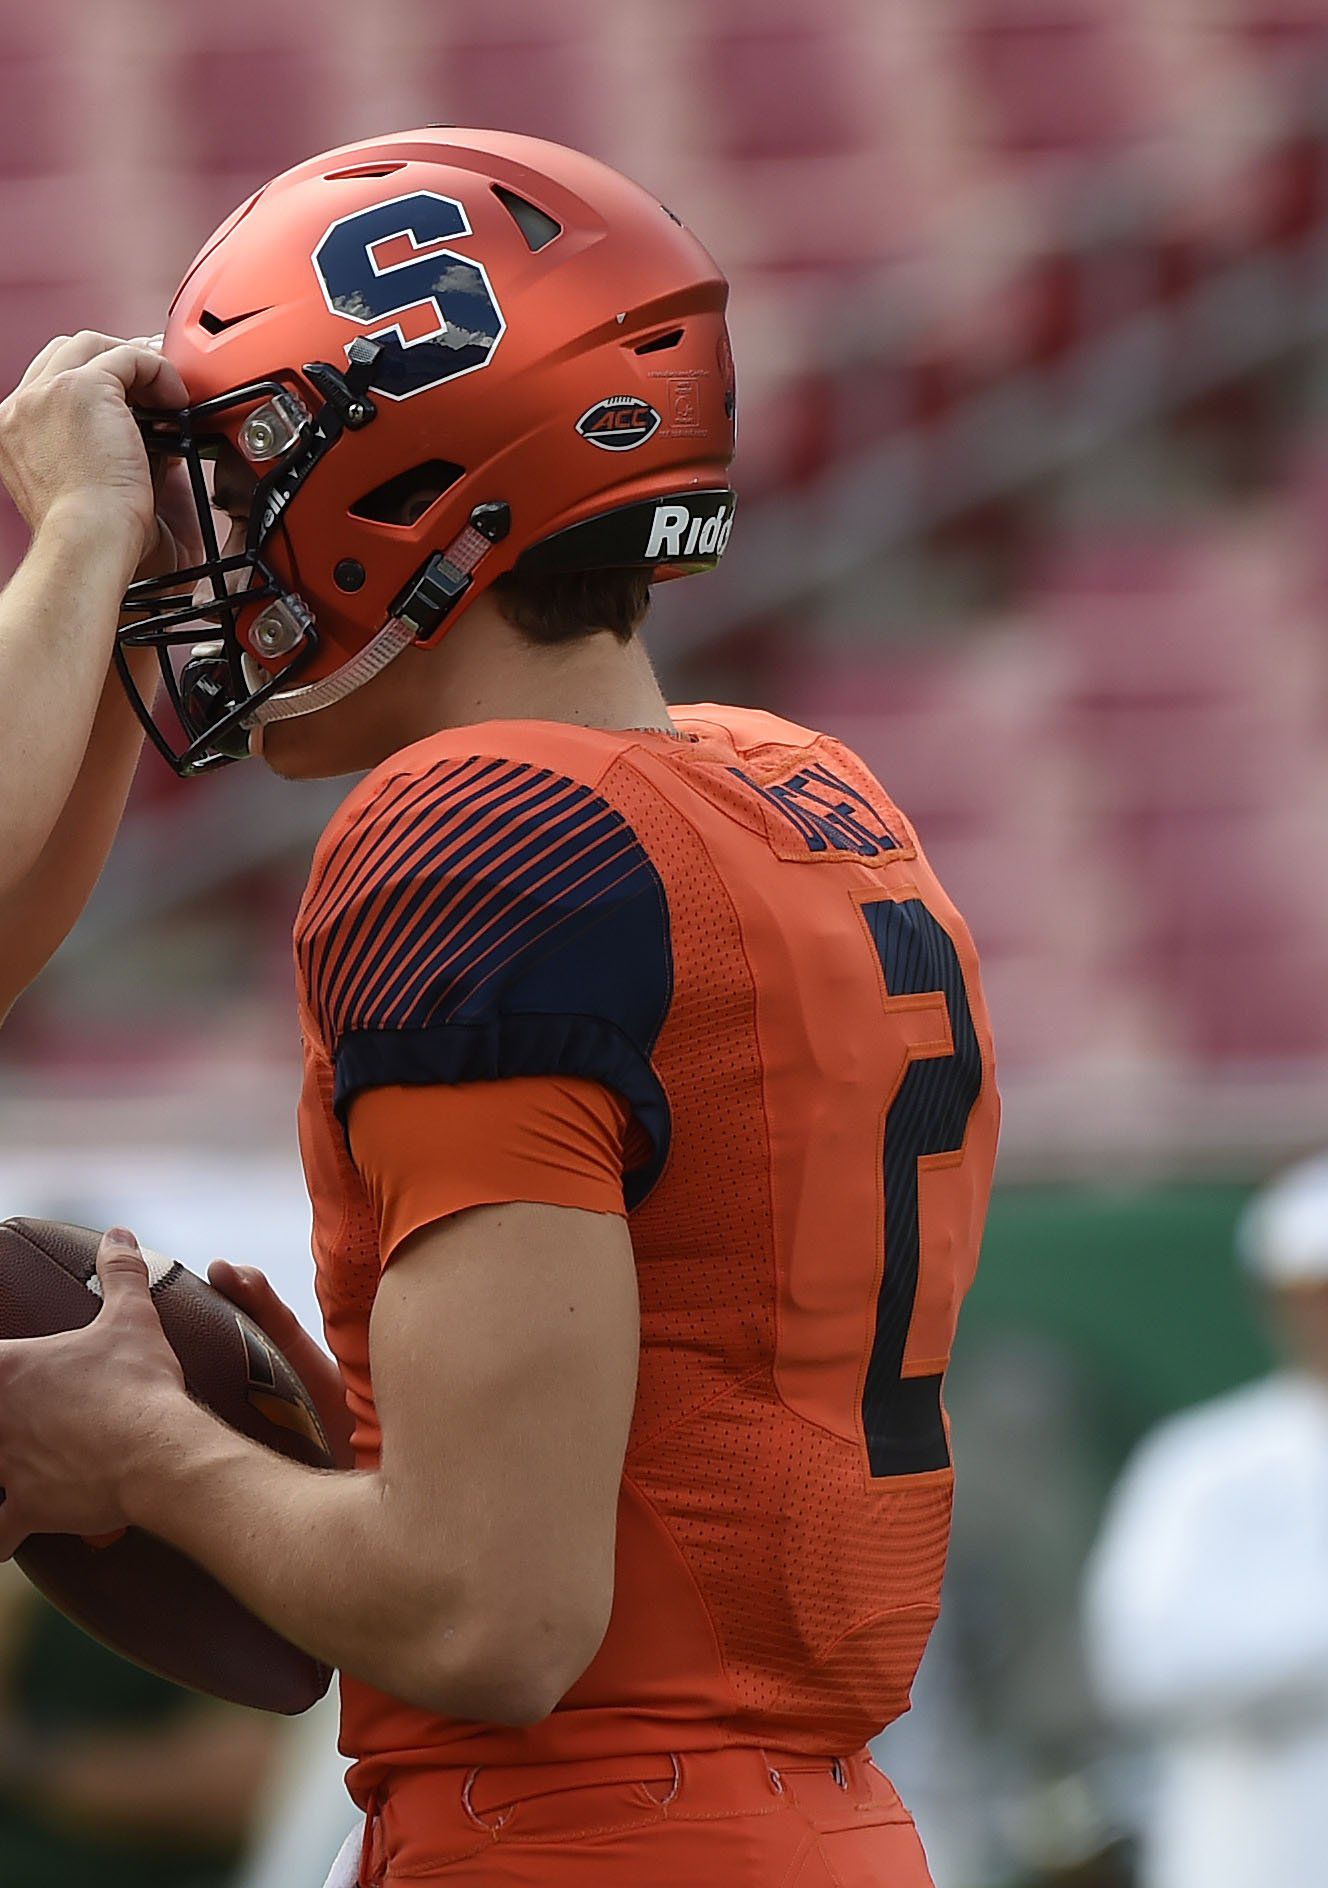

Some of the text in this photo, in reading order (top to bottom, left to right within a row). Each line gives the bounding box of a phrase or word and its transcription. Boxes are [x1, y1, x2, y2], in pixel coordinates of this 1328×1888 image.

[311, 190, 507, 402] S
[591, 408, 649, 431] ACC
[860, 899, 984, 1478] 2
